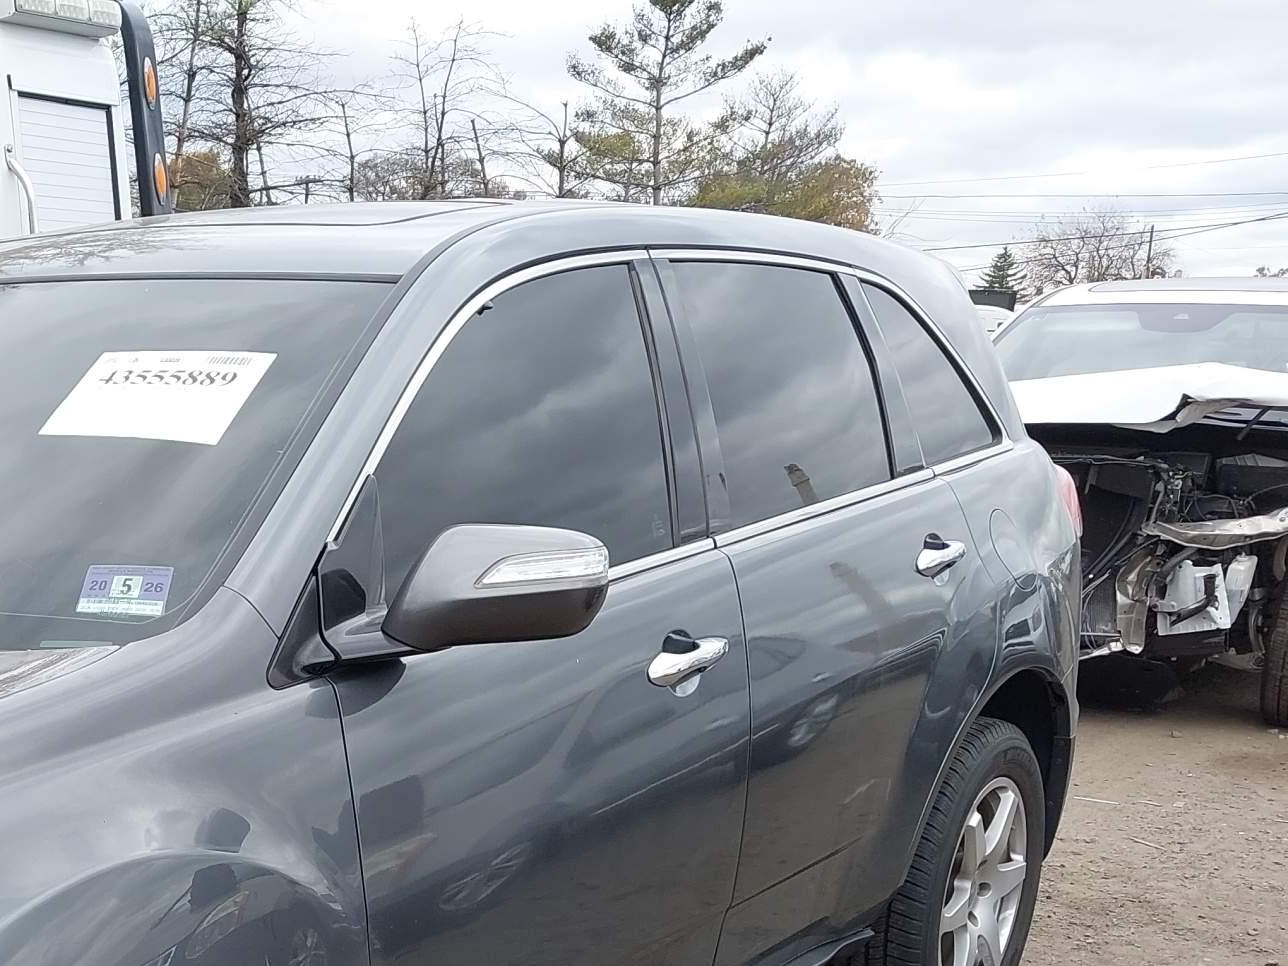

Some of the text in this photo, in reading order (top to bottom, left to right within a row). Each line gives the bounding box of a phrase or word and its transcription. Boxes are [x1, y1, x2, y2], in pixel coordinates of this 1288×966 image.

[99, 369, 238, 387] 43555889
[88, 577, 165, 595] 20 5 26
